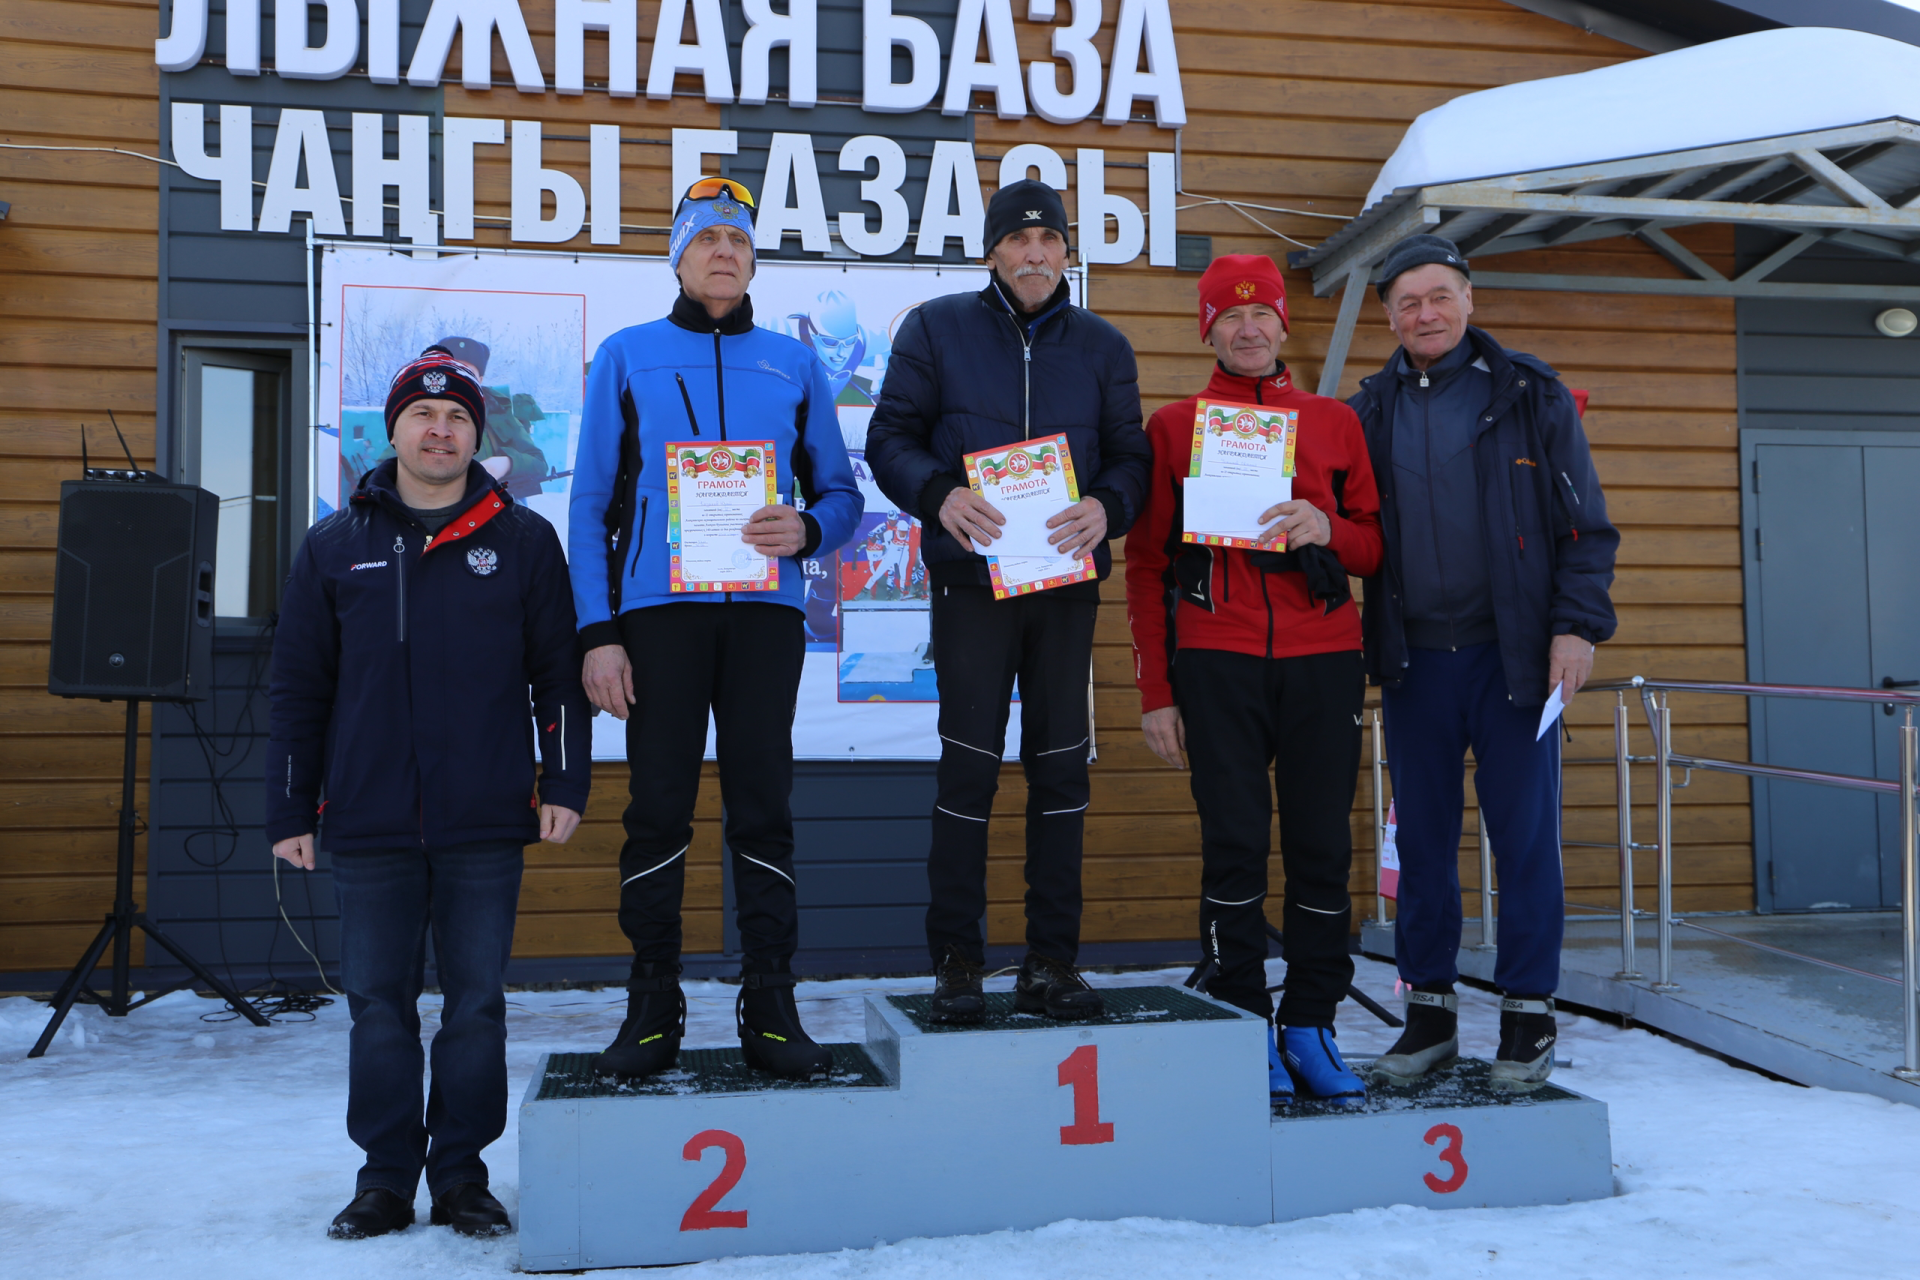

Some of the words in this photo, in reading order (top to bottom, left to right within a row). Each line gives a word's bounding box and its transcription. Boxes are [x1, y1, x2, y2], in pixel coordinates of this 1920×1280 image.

[171, 102, 621, 259] ЧАҢГЫ
[1220, 439, 1267, 453] ГРАМОТА
[697, 480, 747, 490] ГРАМОТА
[1001, 477, 1048, 495] ГРАМОТА
[350, 560, 388, 571] FORWARD
[1412, 993, 1435, 1003] TISA
[1502, 1000, 1524, 1010] TISA
[639, 1033, 663, 1045] FISCHER
[762, 1032, 787, 1042] FISCHER
[1534, 1034, 1550, 1051] TISA
[1058, 1045, 1114, 1145] 1
[1424, 1123, 1468, 1193] 3
[680, 1129, 748, 1232] 2
